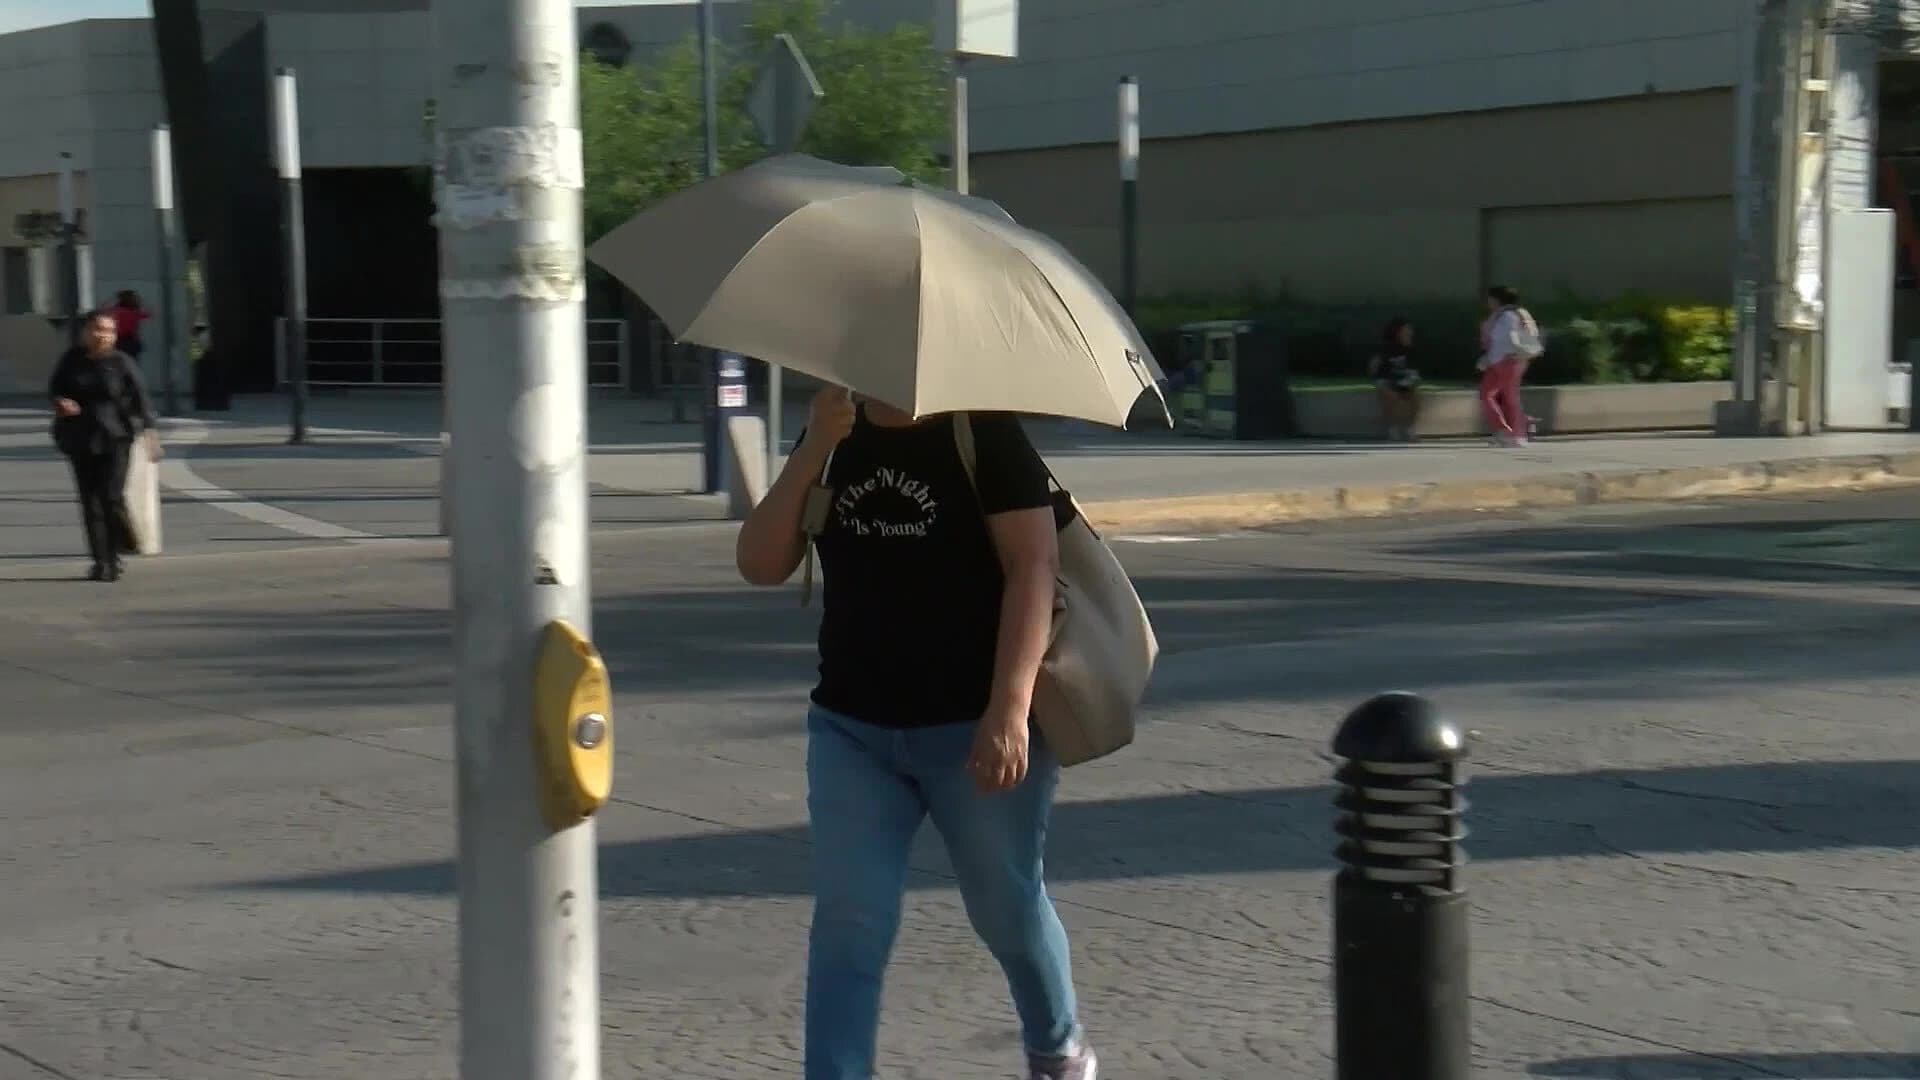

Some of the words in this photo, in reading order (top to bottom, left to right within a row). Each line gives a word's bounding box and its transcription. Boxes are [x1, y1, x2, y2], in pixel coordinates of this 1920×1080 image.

[836, 479, 876, 514] The
[876, 466, 937, 512] Night
[851, 518, 870, 535] Is
[873, 519, 927, 537] Young
